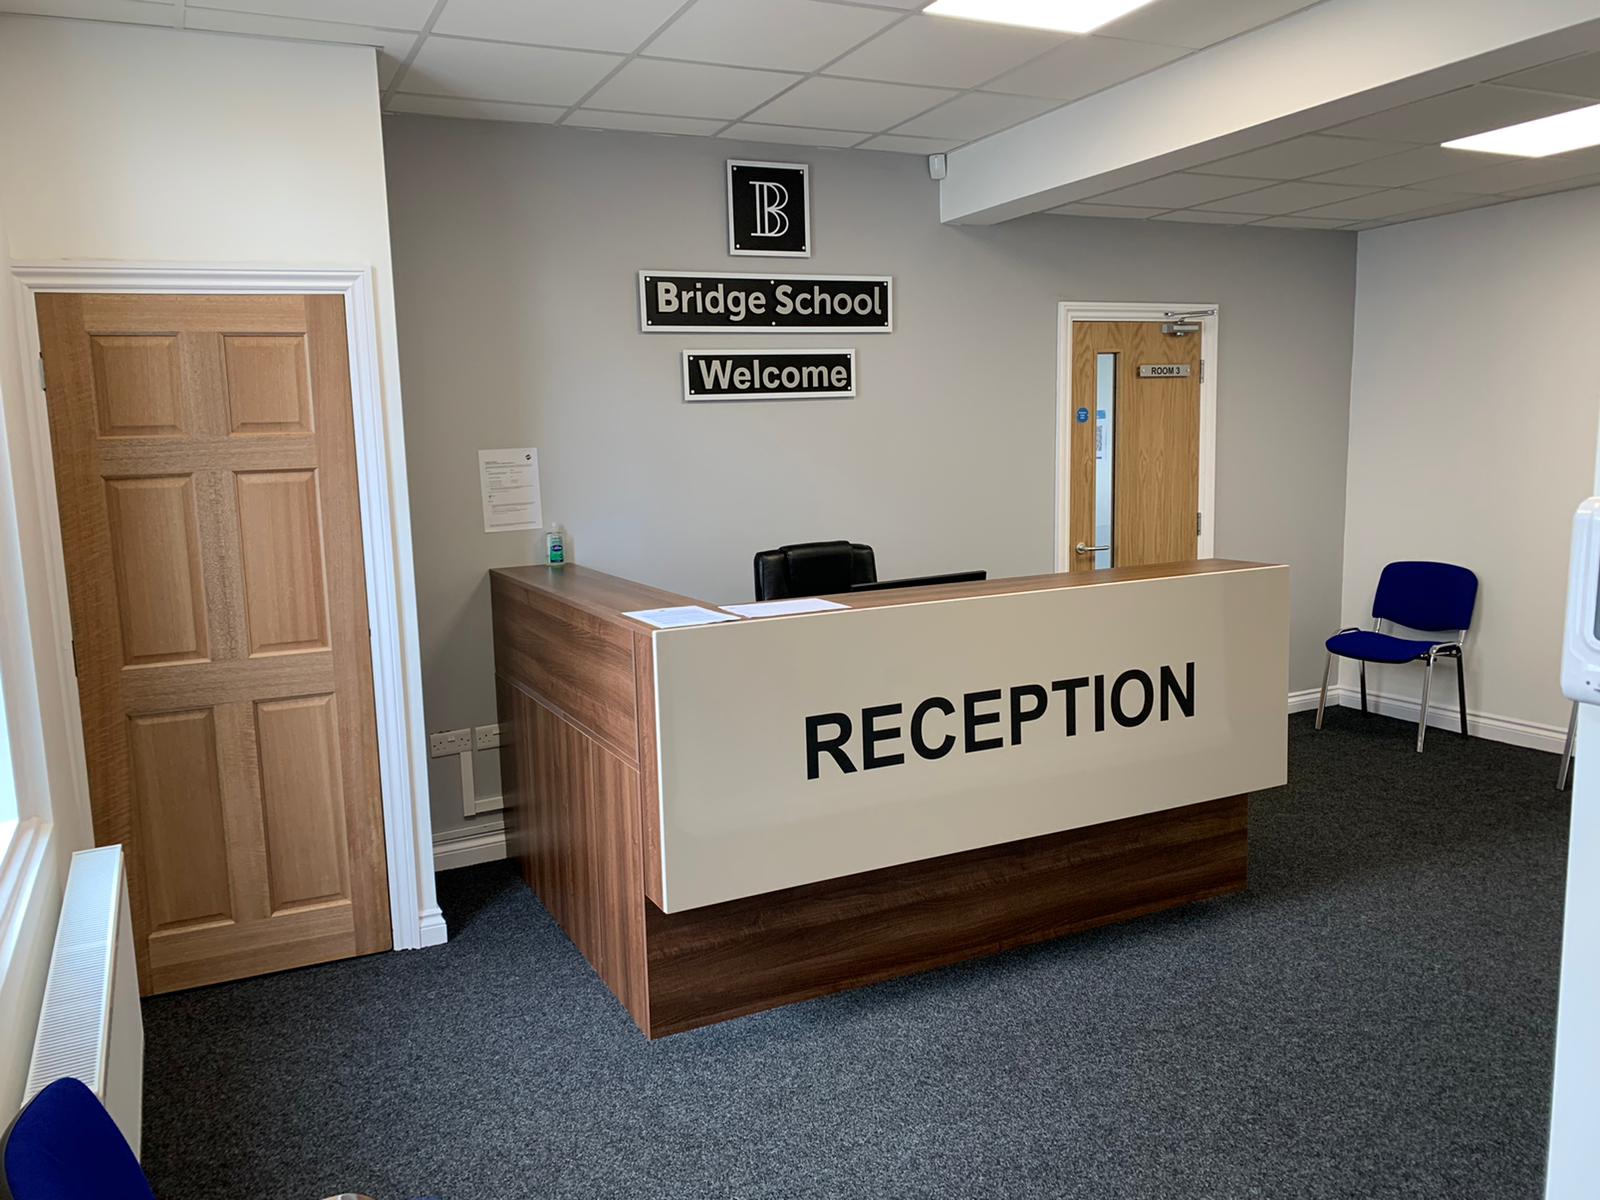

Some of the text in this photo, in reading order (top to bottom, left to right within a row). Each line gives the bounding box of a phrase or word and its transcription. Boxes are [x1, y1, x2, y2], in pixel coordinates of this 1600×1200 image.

[748, 180, 789, 238] B
[656, 281, 883, 322] Bridge School
[698, 359, 848, 390] Welcome
[1151, 366, 1181, 375] ROOM 3
[805, 661, 1195, 780] RECEPTION
